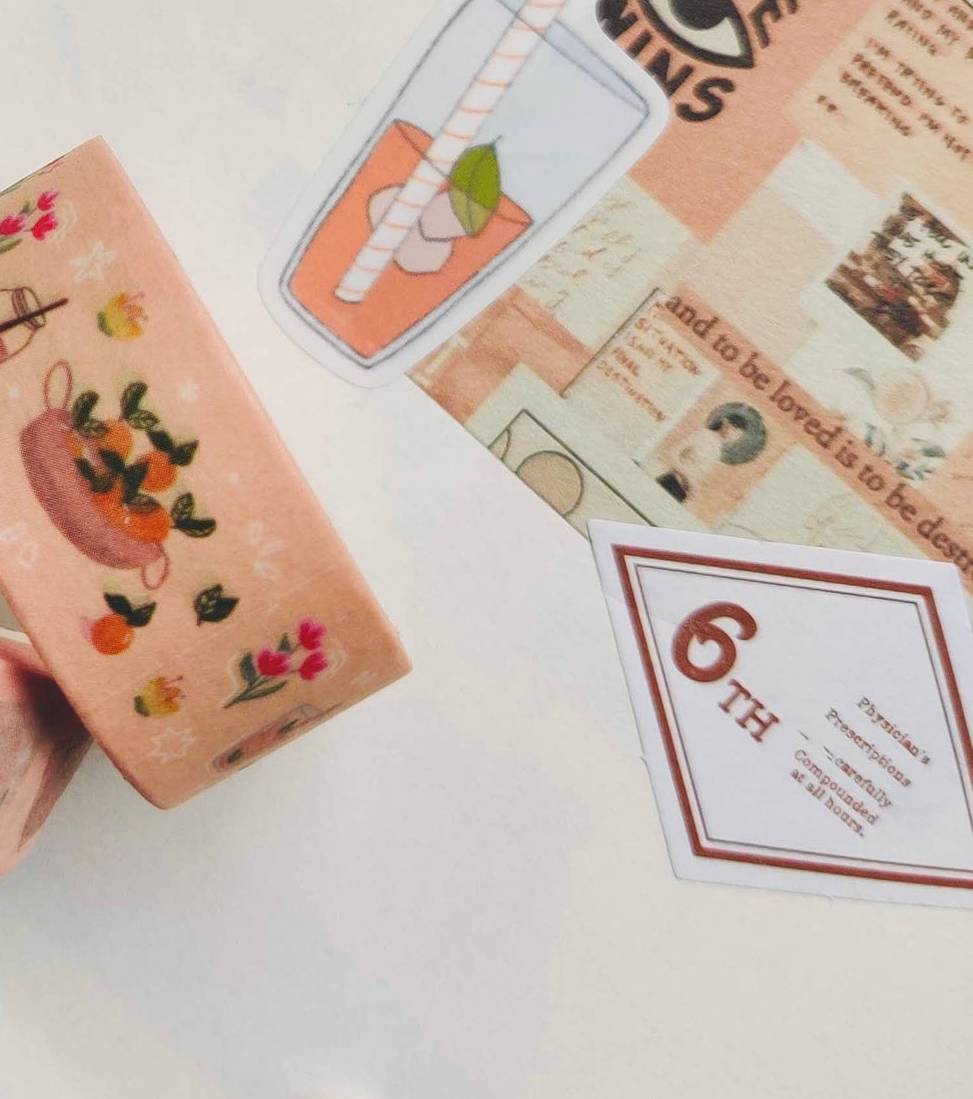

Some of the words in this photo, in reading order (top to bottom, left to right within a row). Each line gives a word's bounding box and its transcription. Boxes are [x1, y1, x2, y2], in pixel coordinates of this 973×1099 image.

[665, 296, 720, 339] and
[713, 334, 740, 362] to
[739, 352, 771, 390] be
[769, 380, 843, 449] loved
[835, 441, 858, 469] is
[858, 464, 885, 491] to
[886, 483, 917, 521] be
[826, 708, 911, 787] Prescriptions
[857, 696, 930, 764] Physician's
[790, 769, 805, 783] at
[806, 782, 825, 800] all
[825, 796, 864, 837] hours.
[794, 749, 879, 825] Compounded
